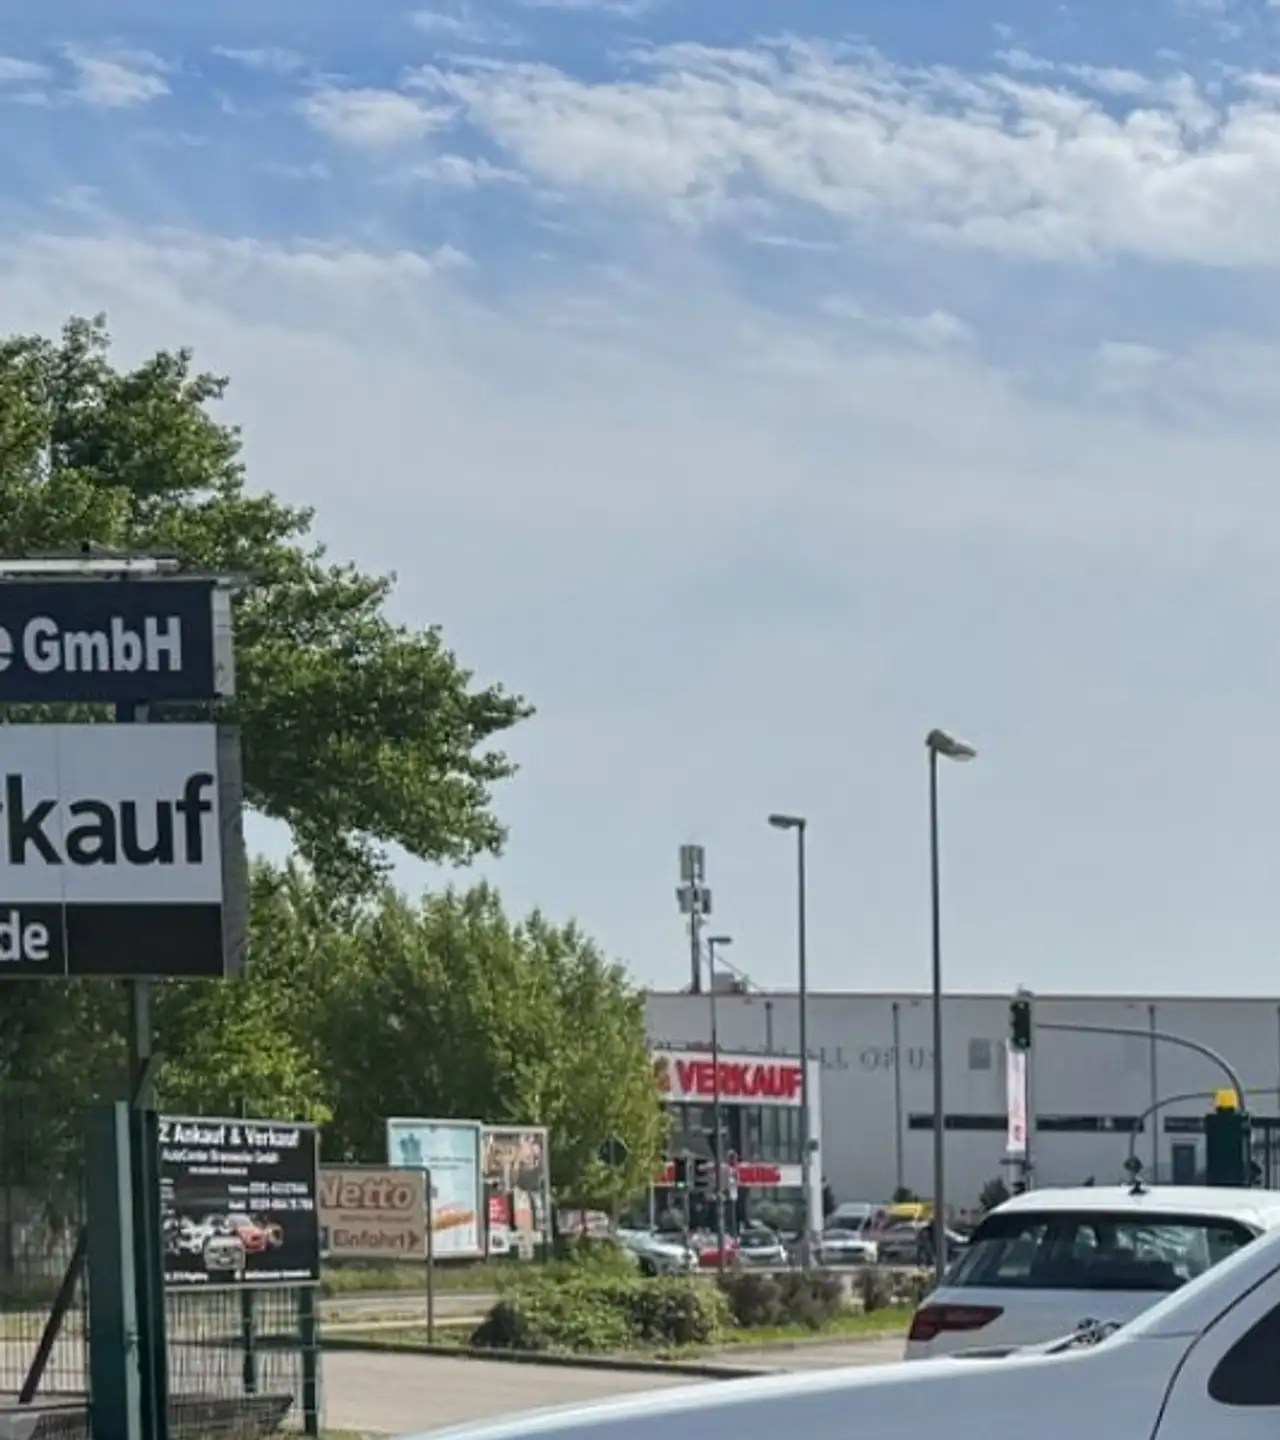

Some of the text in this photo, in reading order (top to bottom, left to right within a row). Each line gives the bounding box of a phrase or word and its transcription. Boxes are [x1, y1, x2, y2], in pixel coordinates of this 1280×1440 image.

[23, 616, 182, 673] GmbH
[0, 772, 214, 867] kauf
[675, 1059, 802, 1098] VERKAUF
[321, 1174, 416, 1210] Netto
